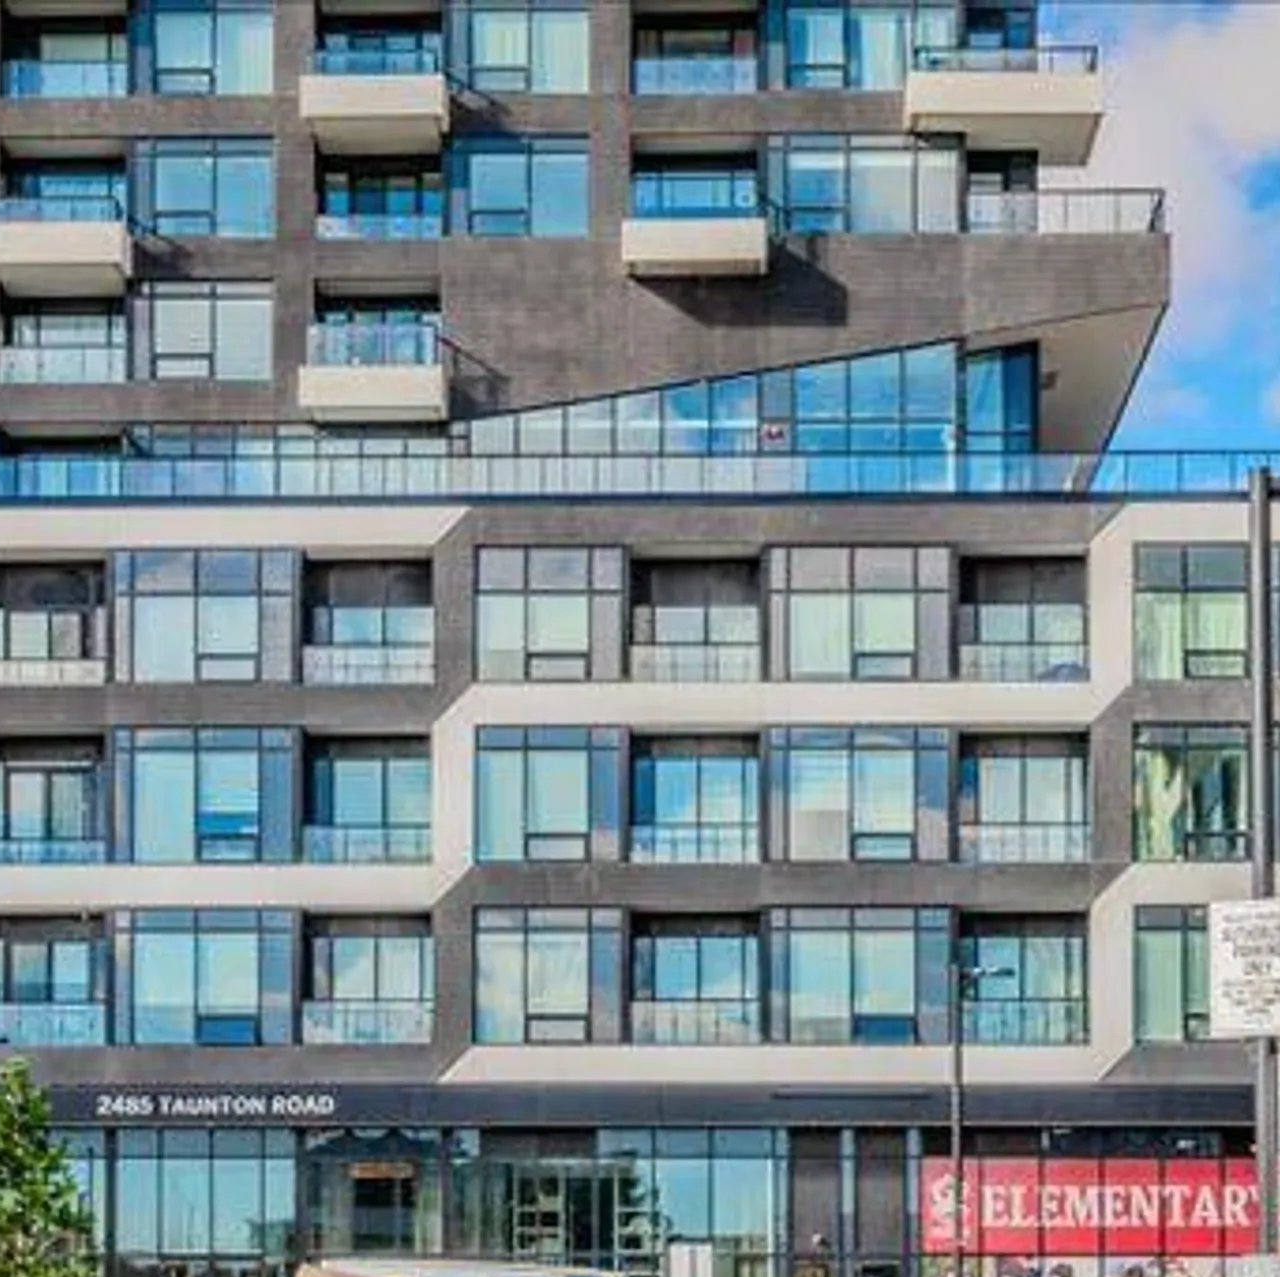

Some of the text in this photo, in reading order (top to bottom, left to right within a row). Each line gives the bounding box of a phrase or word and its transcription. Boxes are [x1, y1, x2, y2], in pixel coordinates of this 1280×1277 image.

[96, 1094, 336, 1115] 2485 TAUNTON ROAD
[981, 1184, 1259, 1228] ELEMENTAR
